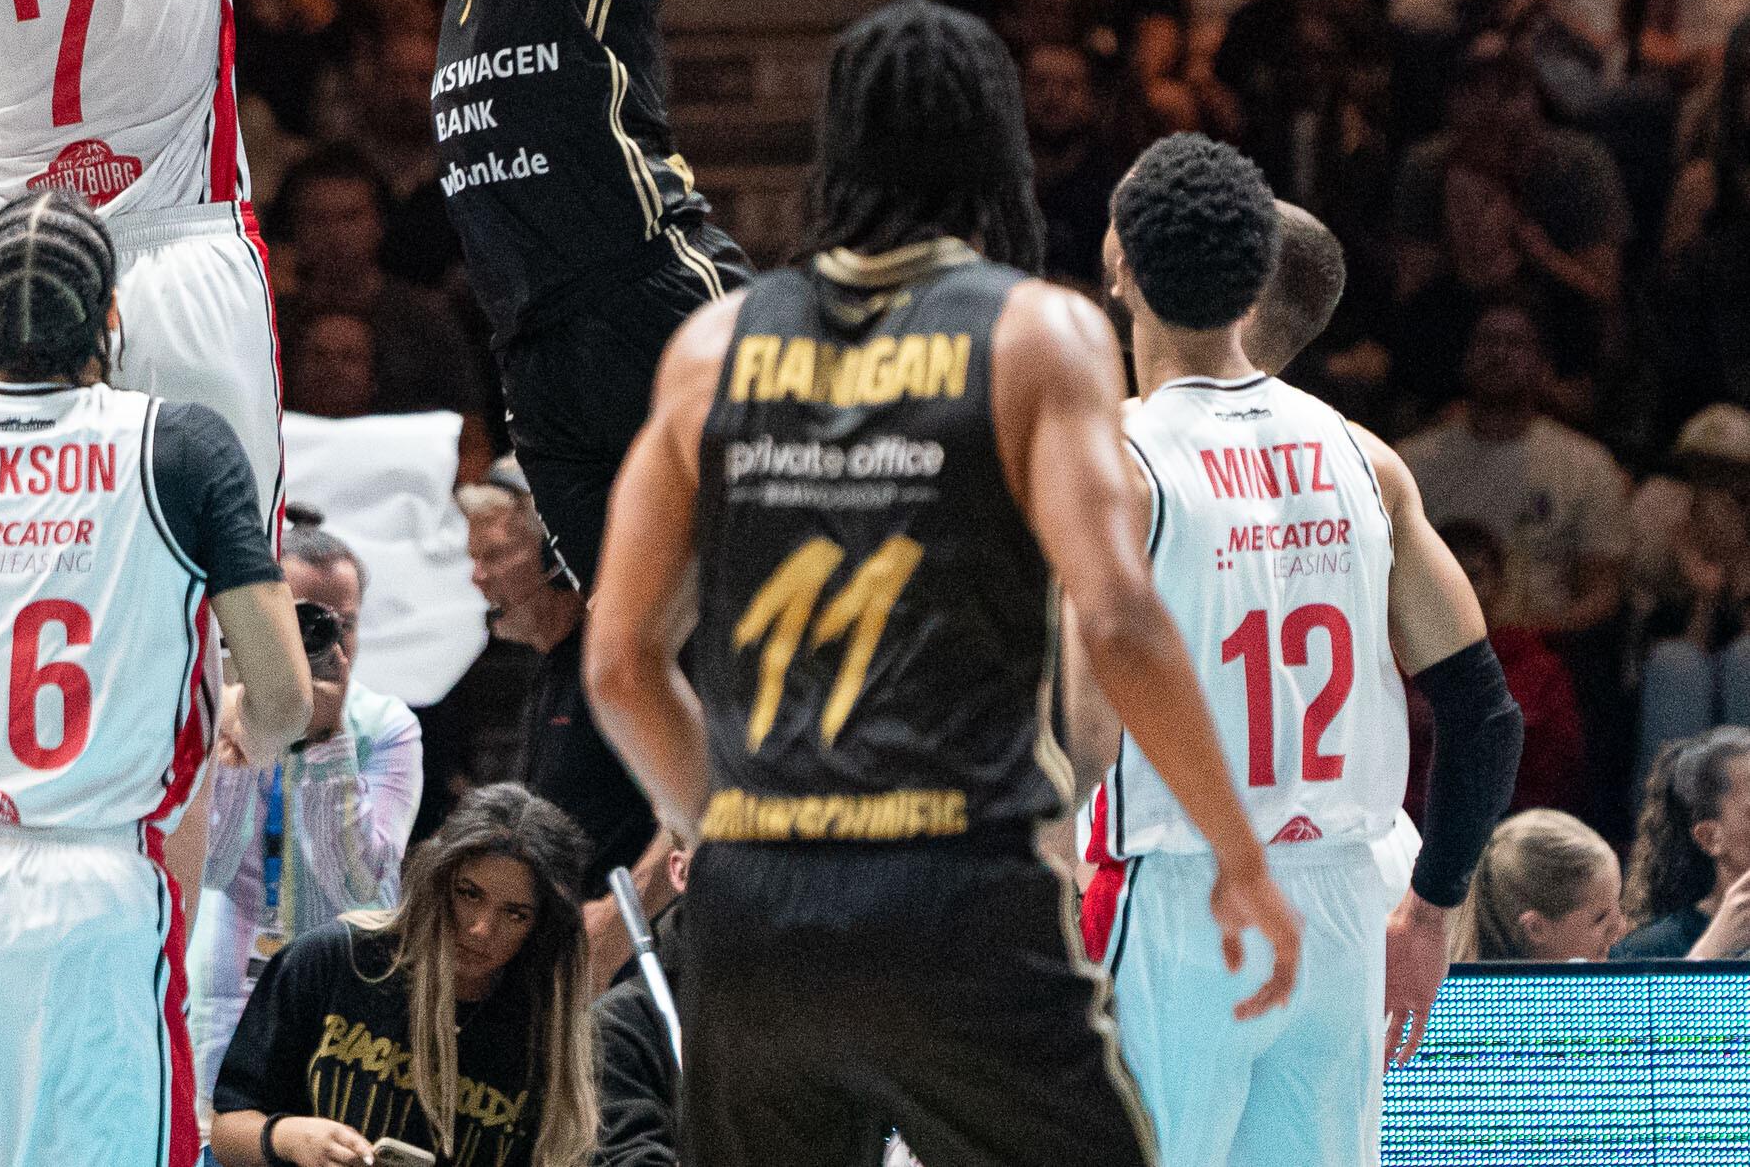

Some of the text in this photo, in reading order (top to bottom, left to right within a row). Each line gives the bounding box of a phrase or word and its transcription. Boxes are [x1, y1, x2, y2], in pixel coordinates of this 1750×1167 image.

[435, 99, 498, 142] BANK
[1200, 441, 1335, 500] MINTZ
[1228, 518, 1351, 553] MECATOR
[1273, 551, 1352, 579] LEASING
[733, 533, 925, 754] 11
[1221, 603, 1354, 787] 12
